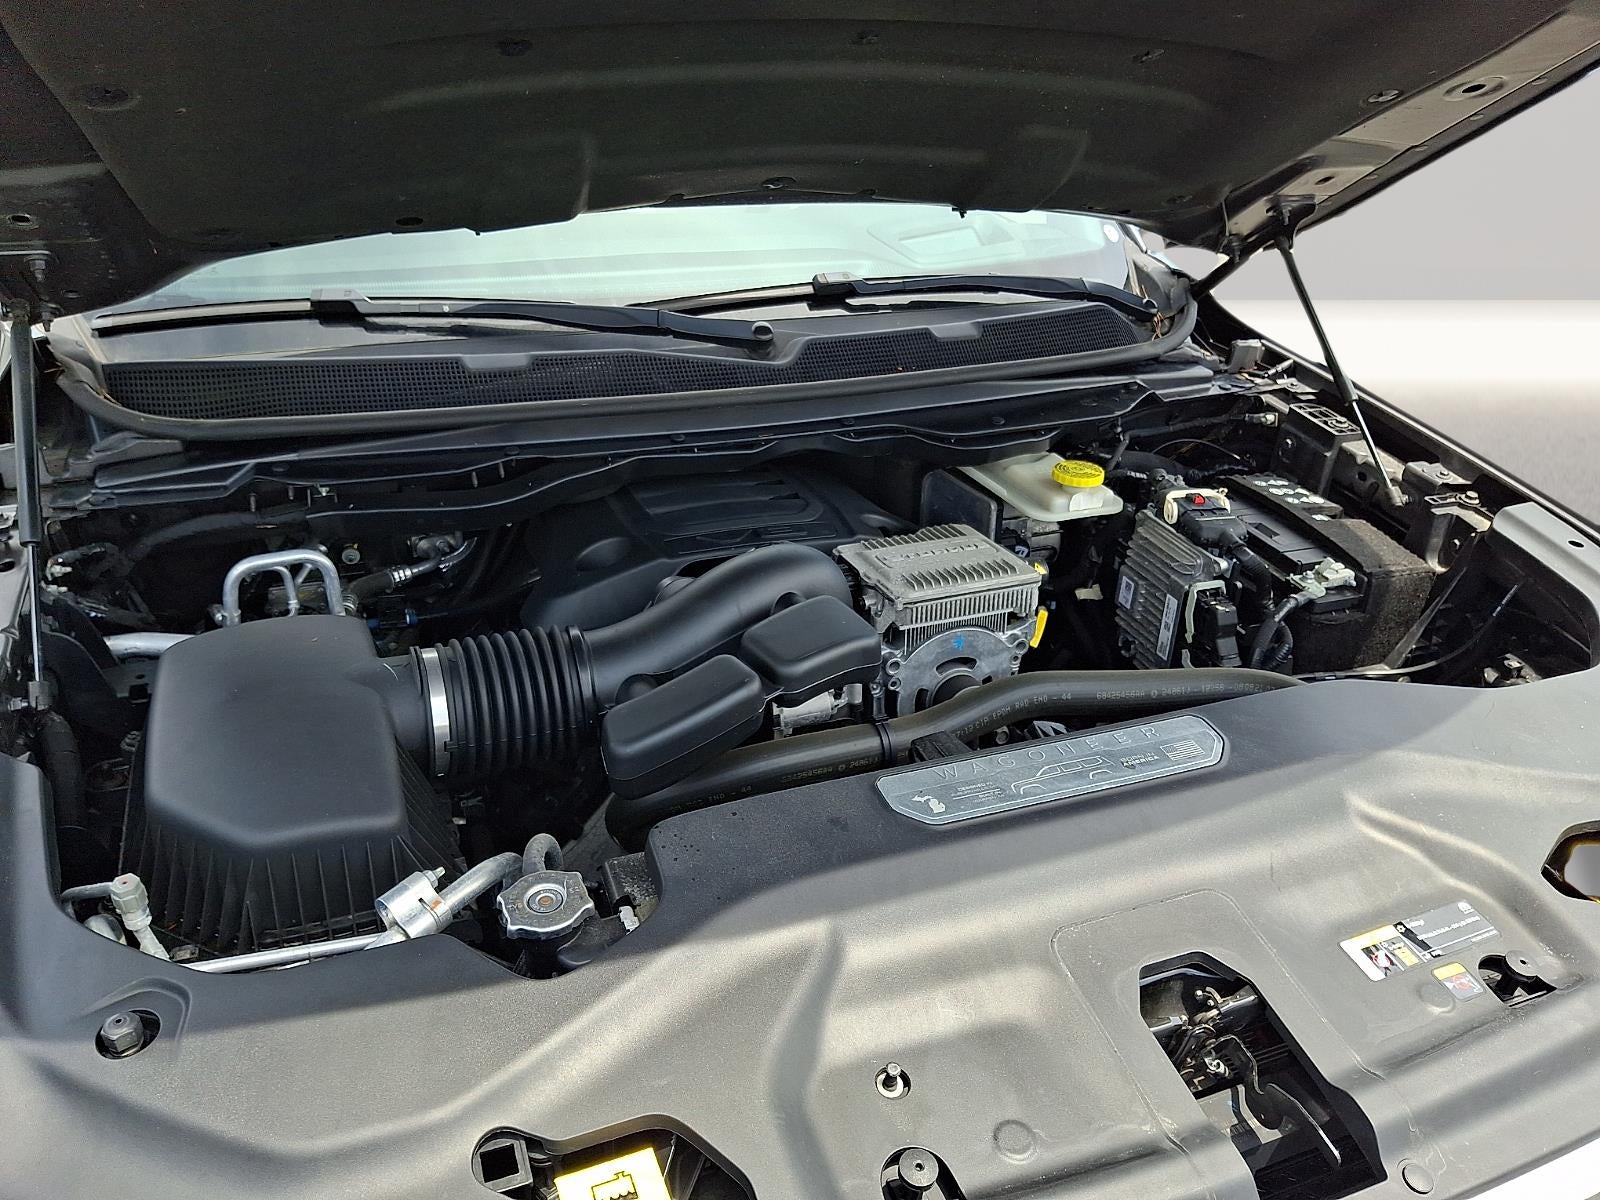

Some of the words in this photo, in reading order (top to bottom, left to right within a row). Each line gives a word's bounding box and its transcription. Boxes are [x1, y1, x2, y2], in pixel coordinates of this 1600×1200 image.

[1033, 695, 1048, 704] END
[937, 727, 1161, 780] WAGONEER
[1123, 755, 1160, 767] AMERICA
